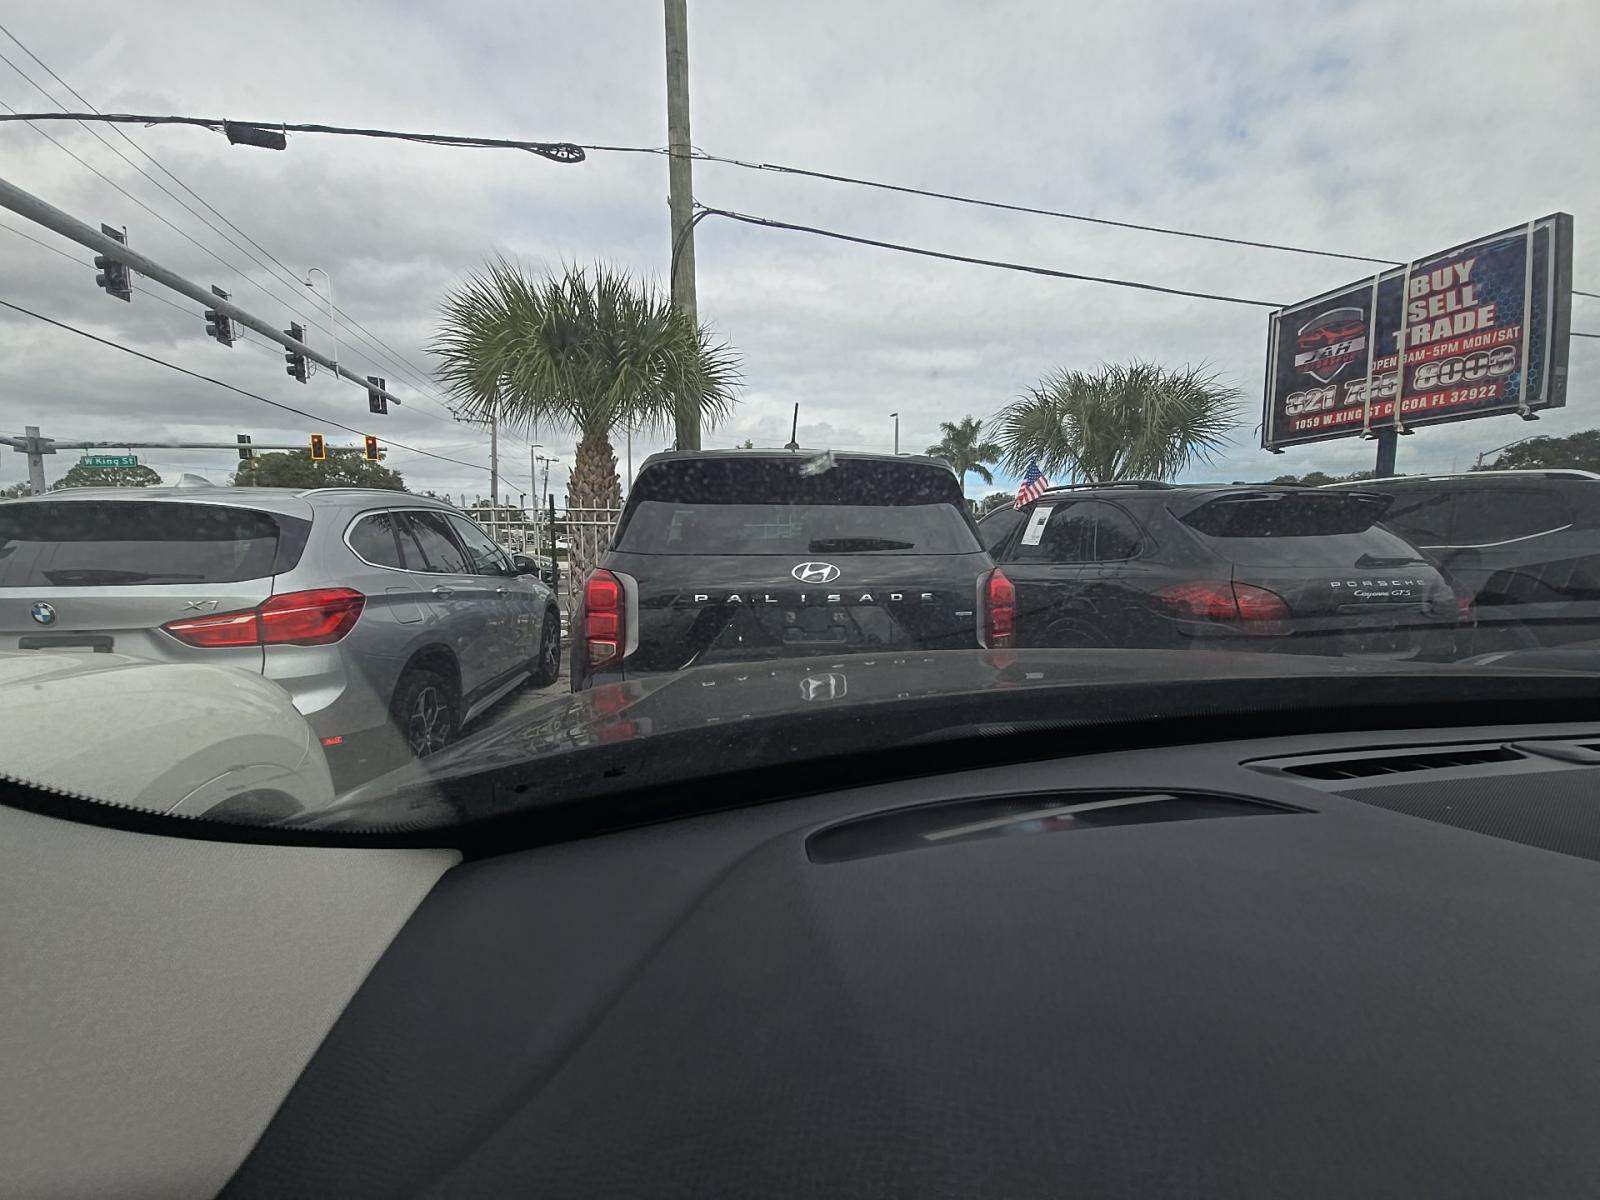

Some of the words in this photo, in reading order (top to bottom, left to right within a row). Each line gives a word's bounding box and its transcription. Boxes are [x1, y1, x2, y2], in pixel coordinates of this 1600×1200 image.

[1409, 259, 1475, 299] BUY
[1407, 285, 1478, 322] SELL
[1392, 304, 1495, 350] TRADE
[1462, 326, 1521, 349] MON/SAT
[1285, 384, 1337, 416] 321
[1413, 345, 1516, 390] 8003
[1295, 417, 1320, 430] 1059
[1431, 393, 1446, 406] FL
[1450, 384, 1497, 403] 32922
[95, 457, 119, 466] King
[121, 457, 135, 465] St
[694, 592, 935, 604] PALISADE
